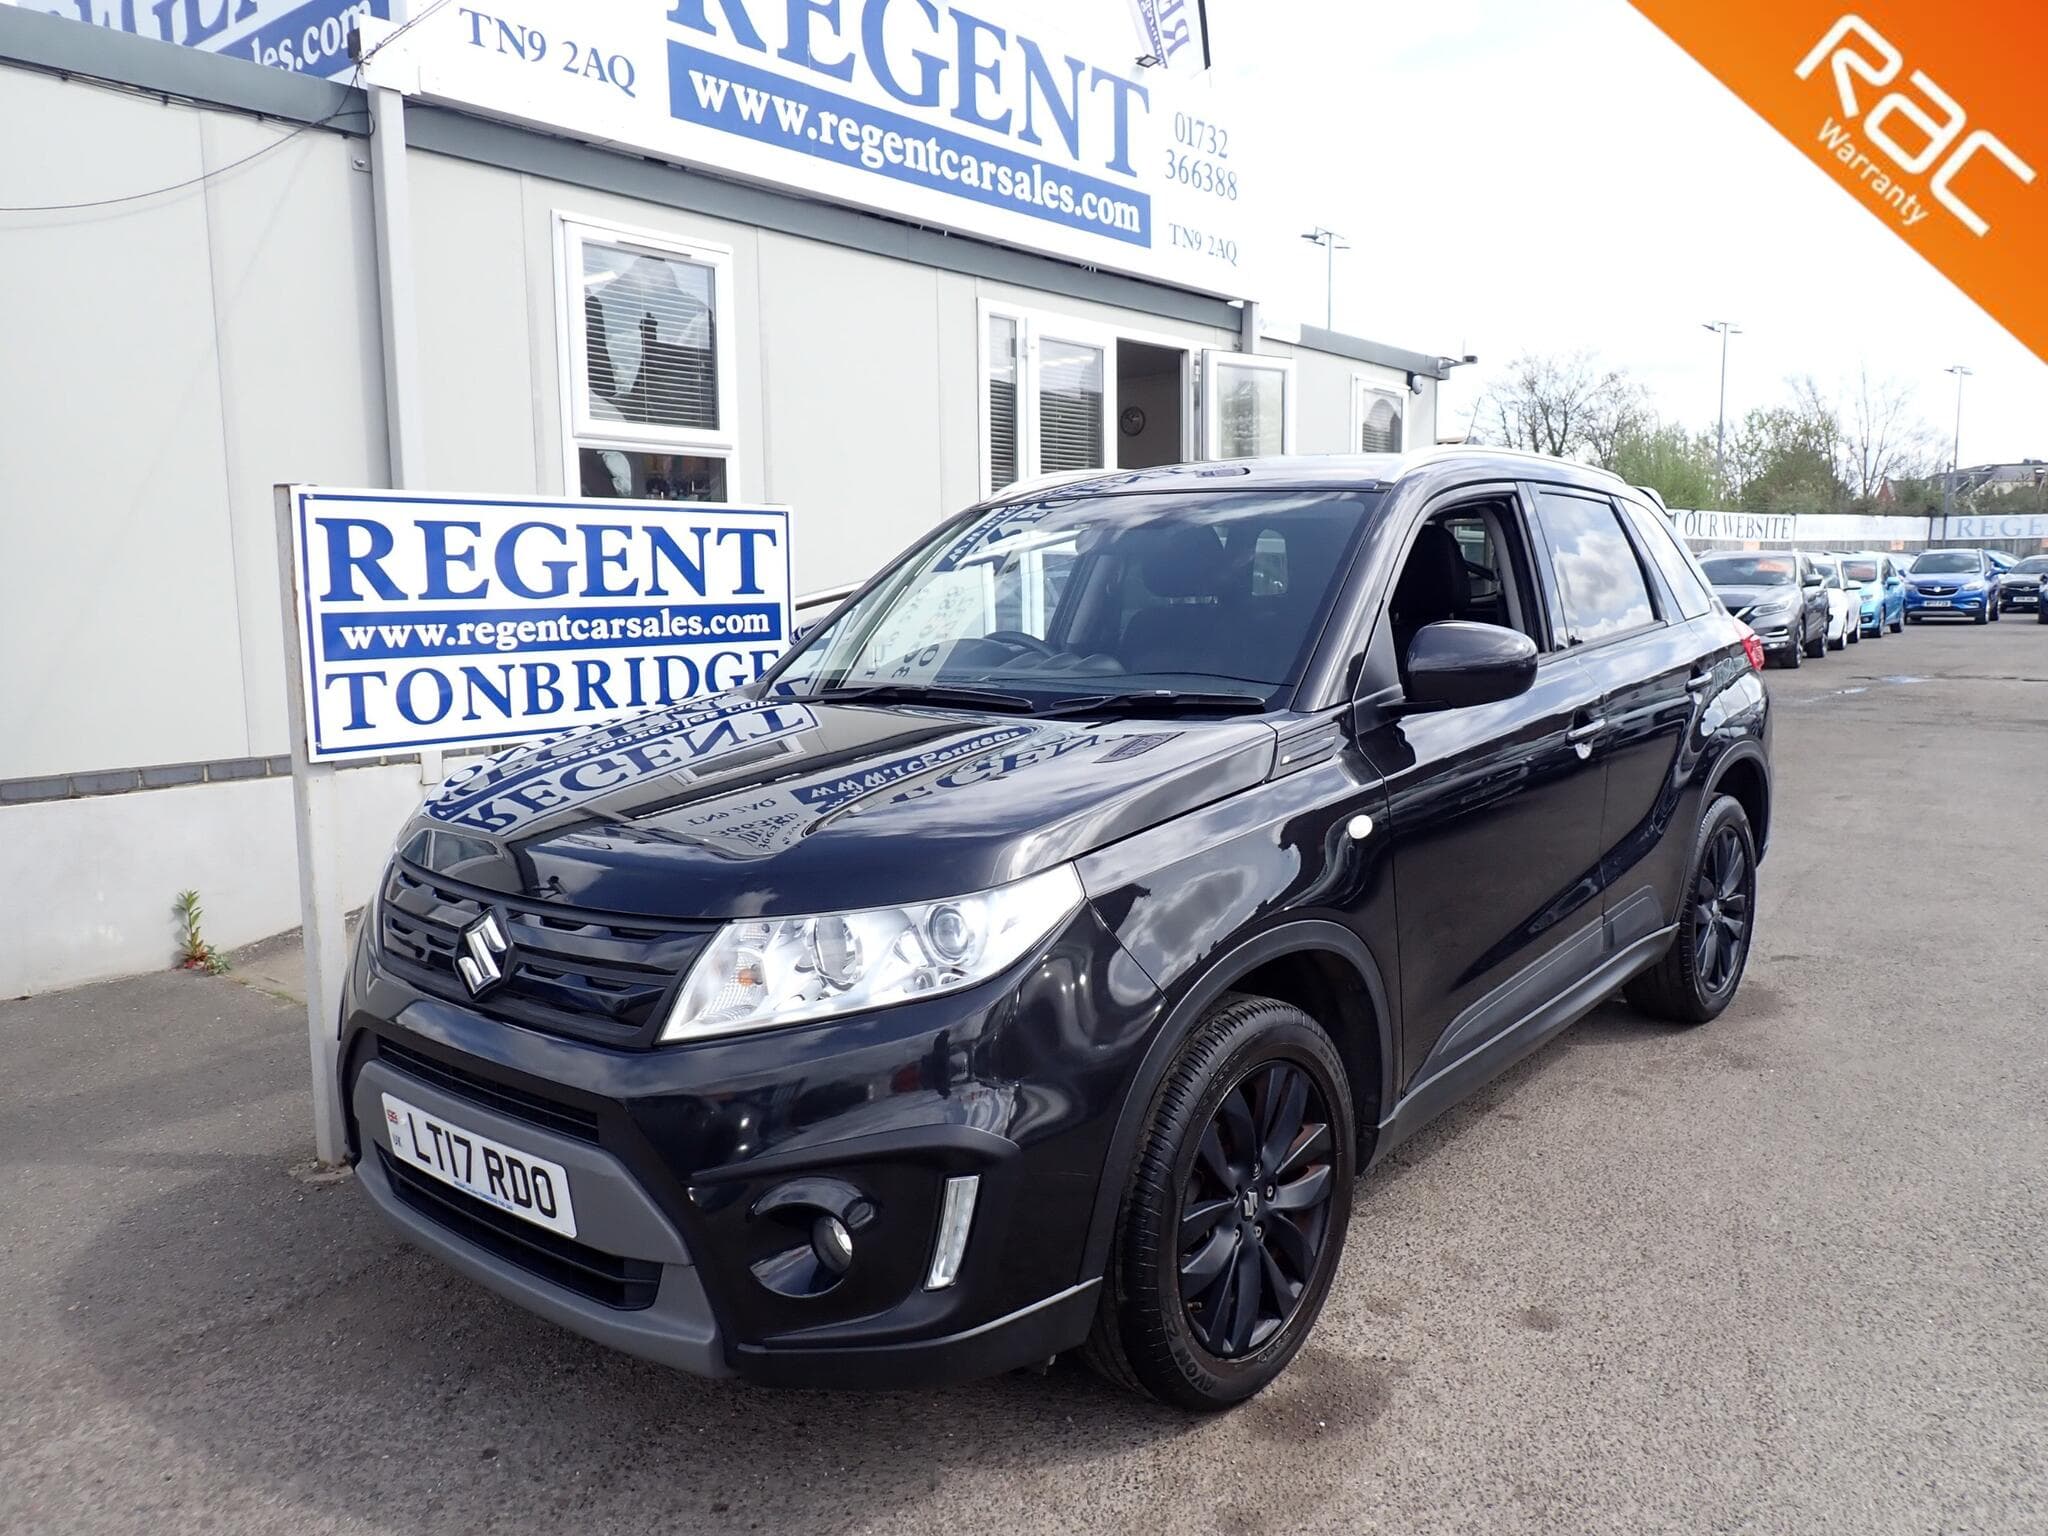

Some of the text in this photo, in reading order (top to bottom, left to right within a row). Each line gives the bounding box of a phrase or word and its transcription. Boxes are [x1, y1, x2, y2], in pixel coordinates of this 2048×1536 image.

[459, 8, 637, 98] TN9 2AQ
[689, 69, 1141, 234] www.regentcarsales.com
[1174, 111, 1228, 159] 01732
[1165, 149, 1238, 201] 366388
[1168, 222, 1238, 268] TN9 2AQ
[1684, 511, 1718, 537] OUR
[1723, 513, 1791, 539] WEBSITE
[315, 517, 777, 602] REGENT
[339, 608, 771, 650] www.regentcarsales.com
[407, 1111, 473, 1185] LT17
[482, 1146, 557, 1219] RDO
